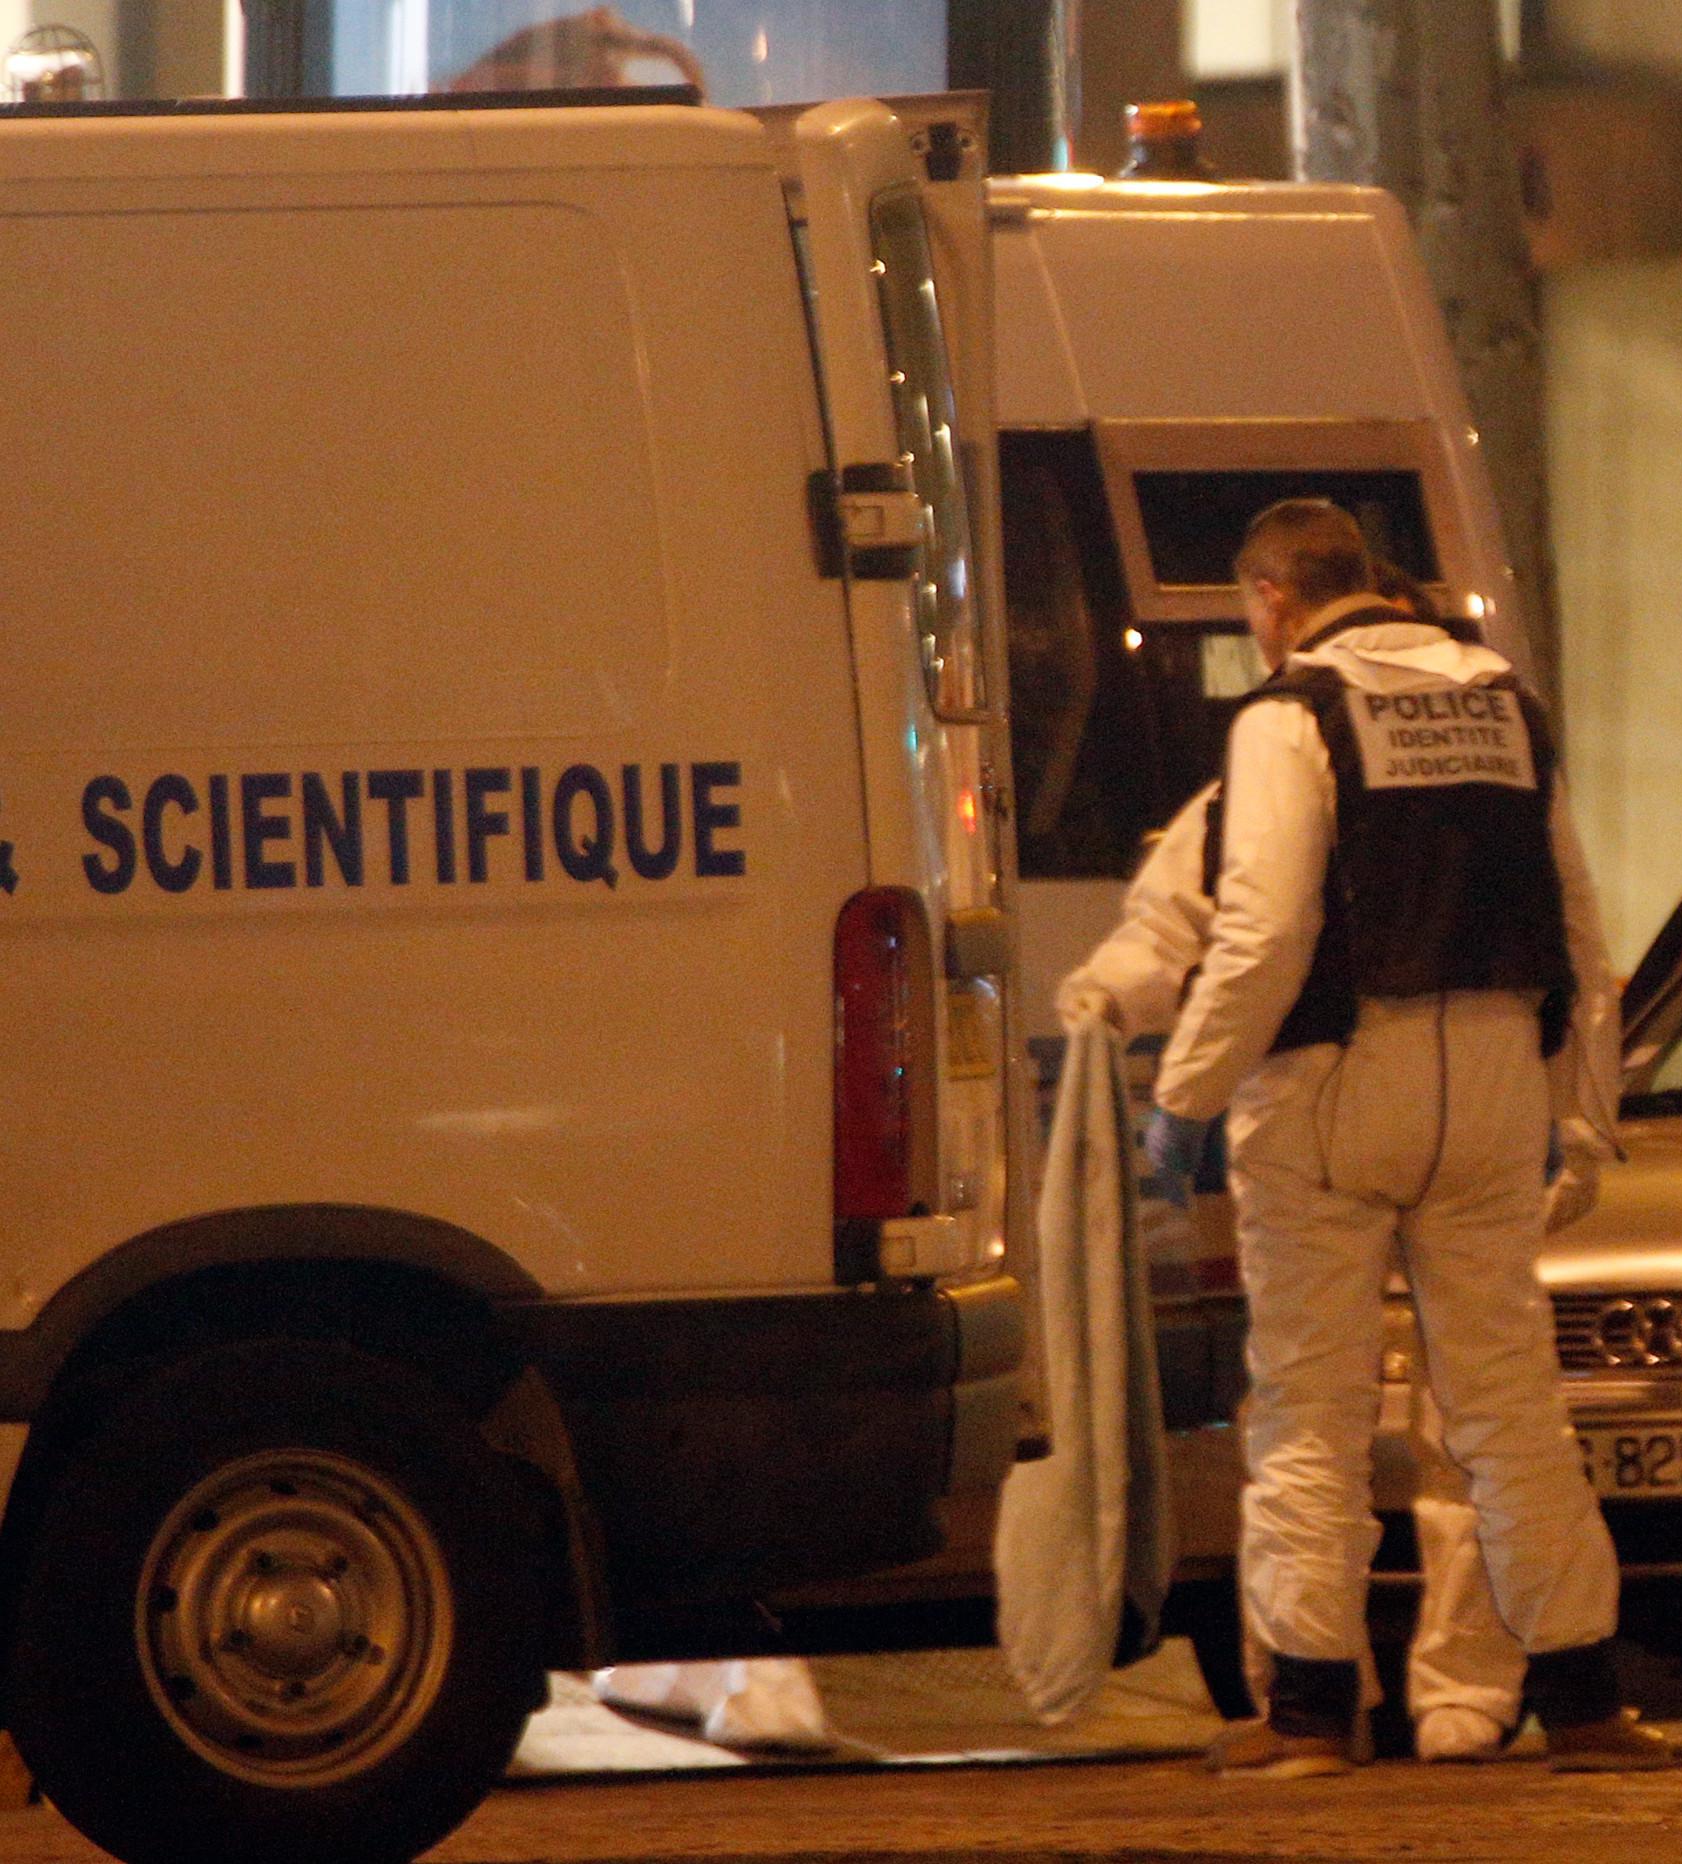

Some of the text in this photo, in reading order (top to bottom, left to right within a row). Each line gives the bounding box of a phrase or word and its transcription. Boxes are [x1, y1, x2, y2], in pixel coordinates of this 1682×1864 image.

[1364, 689, 1511, 722] POLICE
[1388, 726, 1508, 749] IDENTITE
[81, 761, 747, 895] SCIENTIFIQUE
